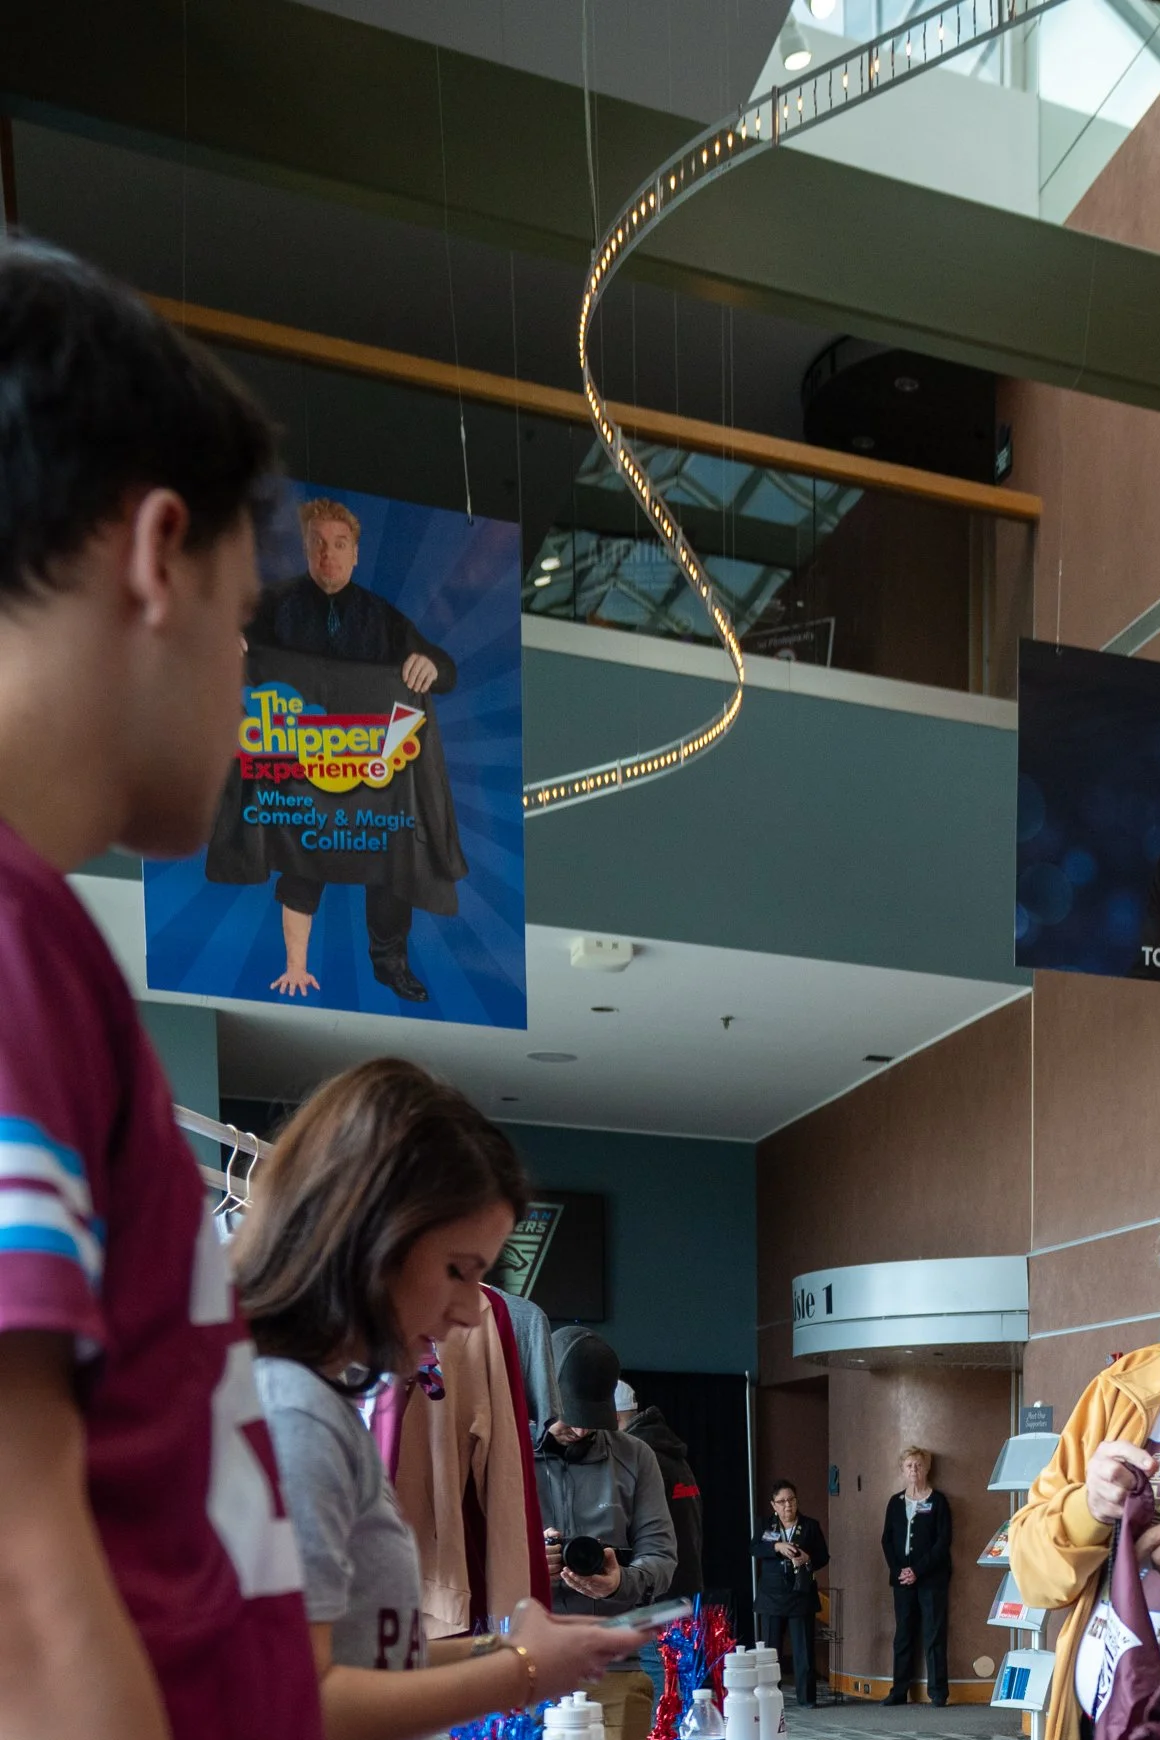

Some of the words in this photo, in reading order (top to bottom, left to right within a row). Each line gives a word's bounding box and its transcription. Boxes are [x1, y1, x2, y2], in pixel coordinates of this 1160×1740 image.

[588, 537, 676, 568] ATTENTIO
[251, 690, 304, 714] The
[238, 716, 386, 758] Chipper
[241, 753, 386, 785] Experience
[256, 791, 314, 808] Where
[243, 805, 329, 831] Comedy
[334, 808, 349, 827] &
[355, 809, 416, 832] Magic
[300, 829, 388, 851] Collide!
[793, 1287, 815, 1322] isle
[821, 1283, 833, 1315] 1
